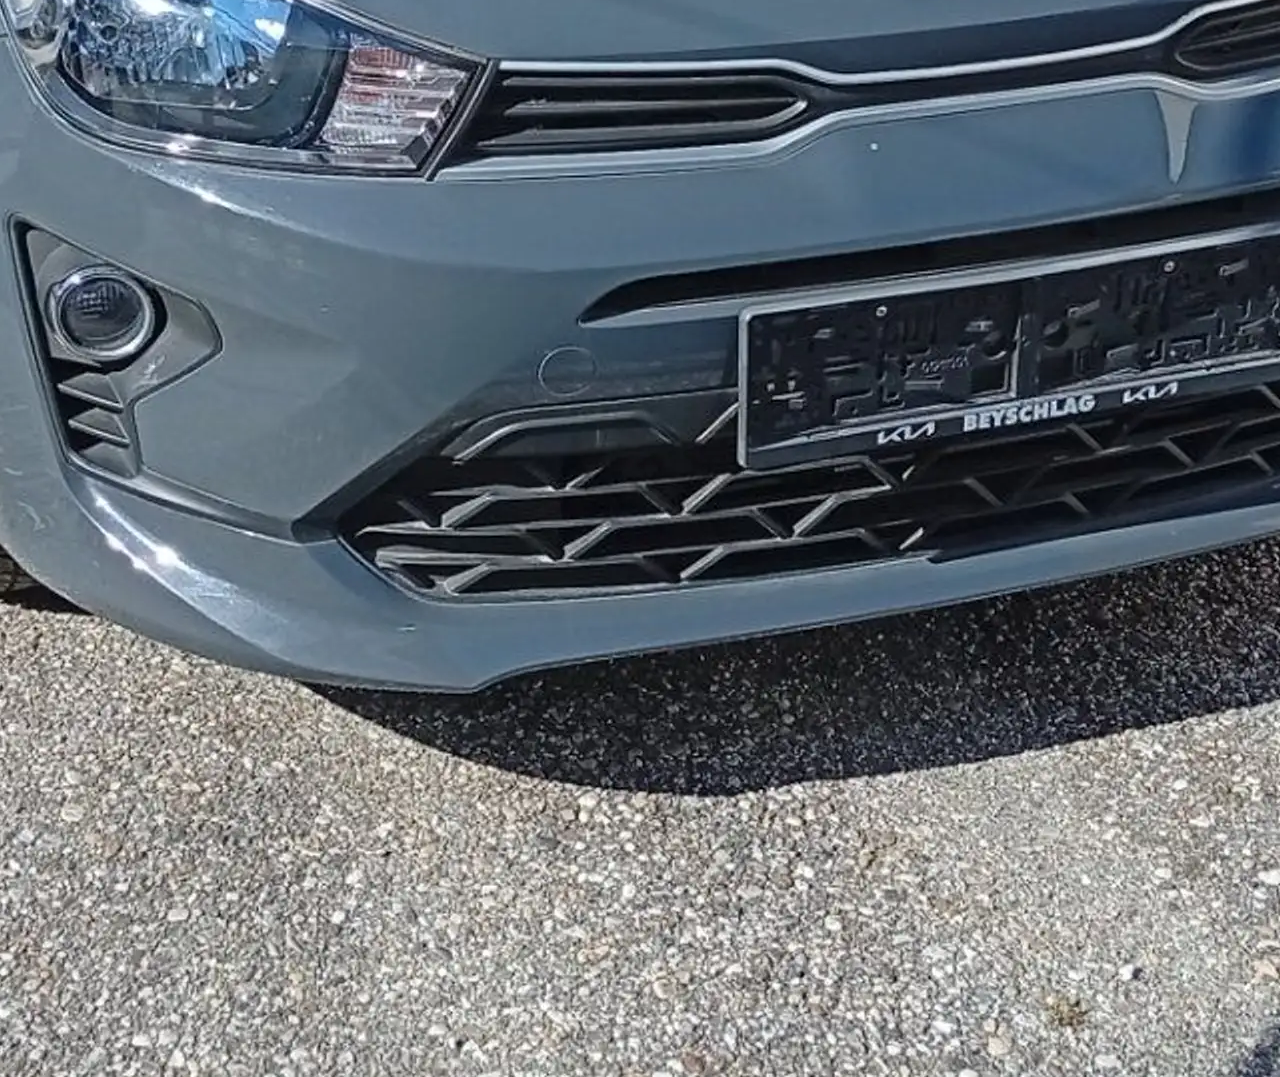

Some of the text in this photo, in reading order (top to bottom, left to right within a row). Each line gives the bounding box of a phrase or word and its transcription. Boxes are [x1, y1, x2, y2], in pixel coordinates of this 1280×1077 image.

[877, 381, 1179, 445] KIA BEYSCHLAG KIA
